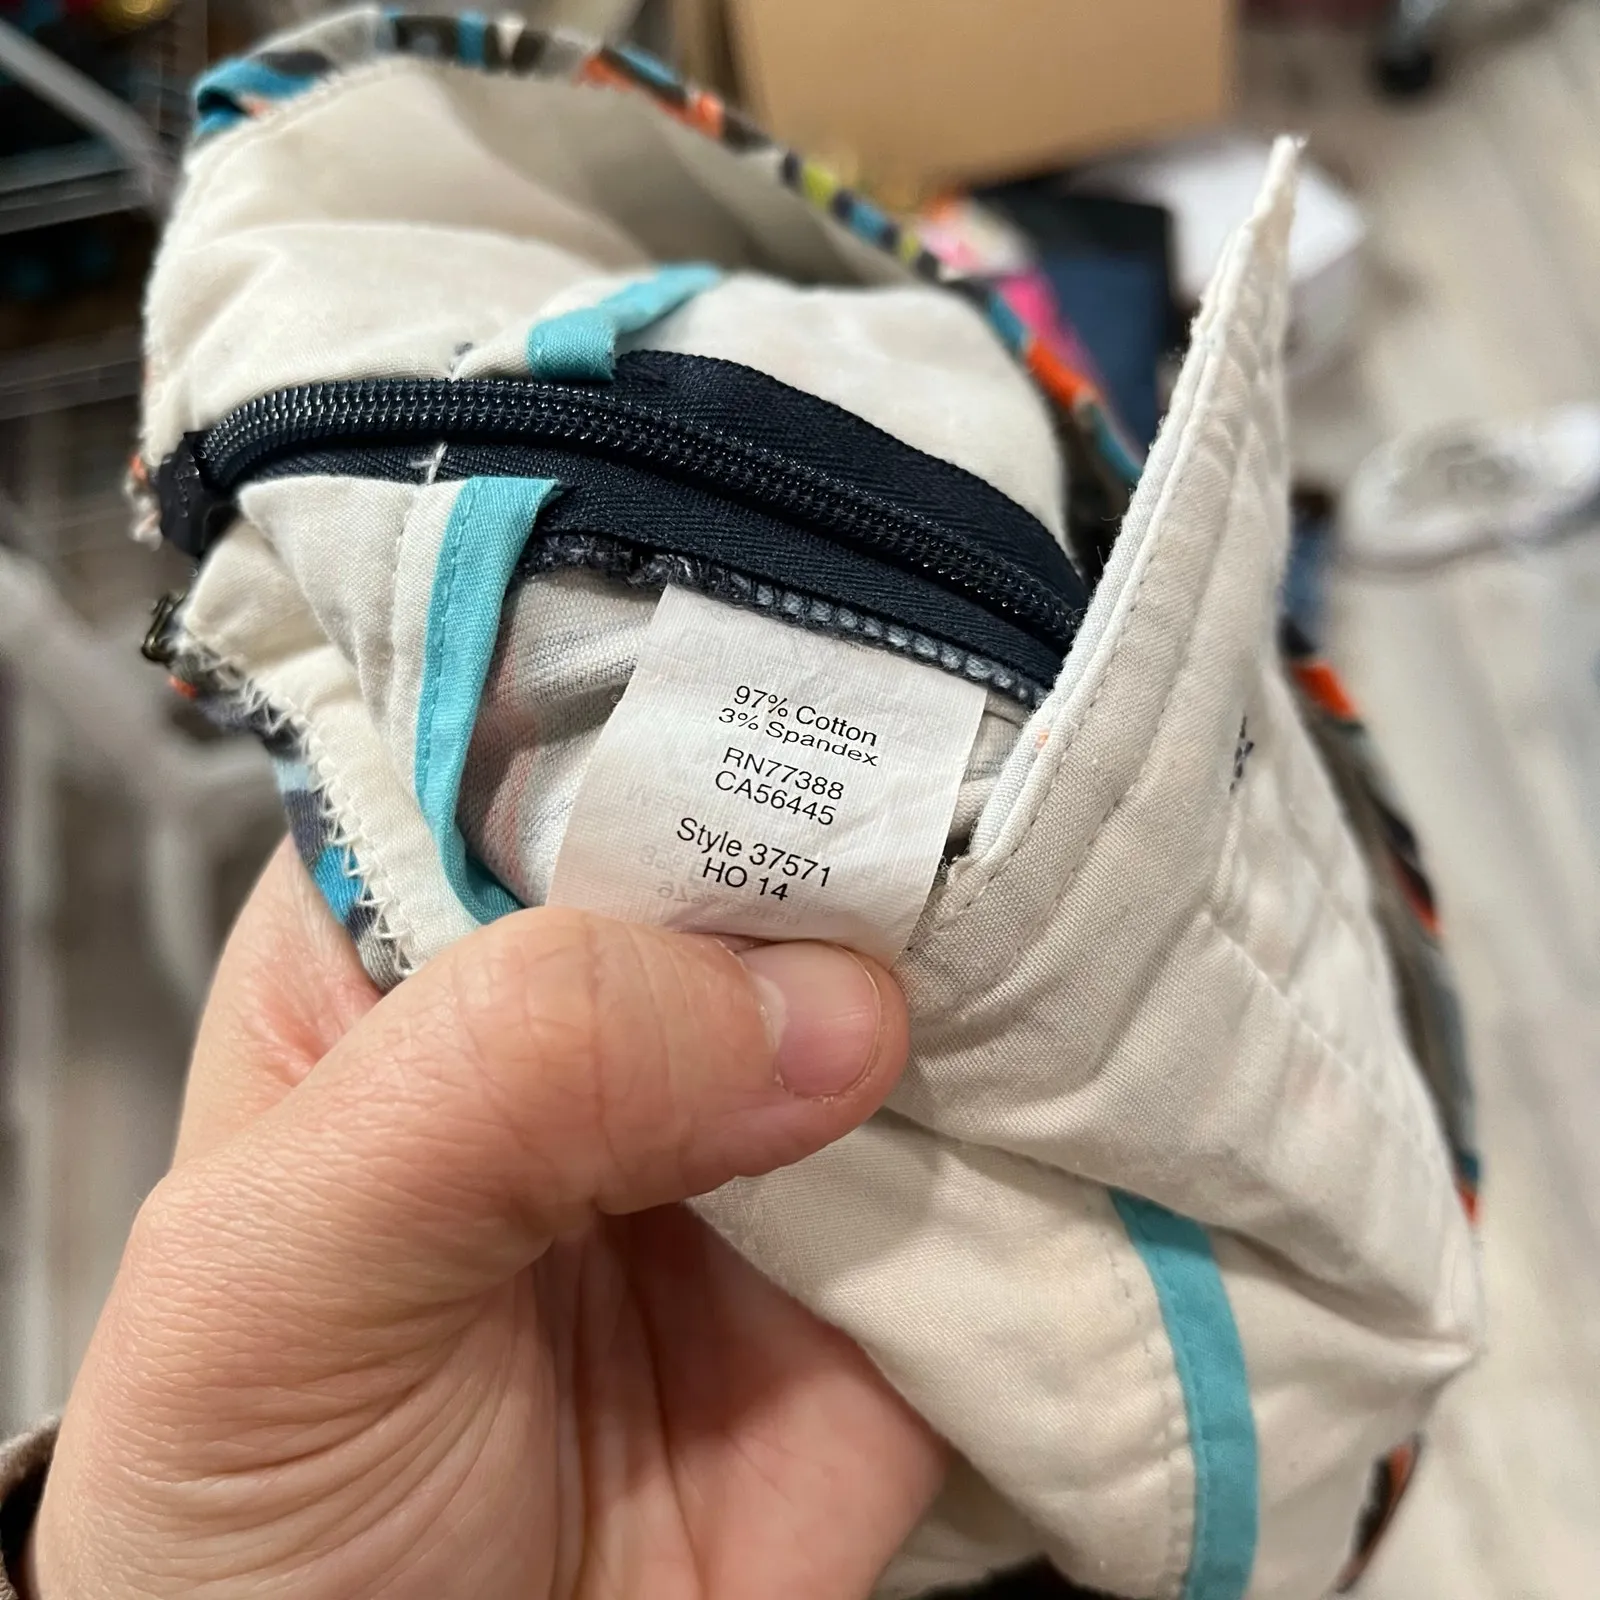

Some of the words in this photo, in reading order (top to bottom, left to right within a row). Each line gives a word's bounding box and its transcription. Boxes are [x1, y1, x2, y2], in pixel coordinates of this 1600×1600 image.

[718, 708, 759, 730] 3%
[765, 721, 878, 766] Spandex
[734, 685, 788, 717] 97%
[796, 705, 877, 746] Cotton
[715, 770, 836, 825] CA56445
[722, 747, 844, 800] RN77388
[677, 817, 742, 857] Style
[750, 843, 830, 887] 37571
[702, 857, 747, 888] HO
[759, 877, 788, 900] 14
